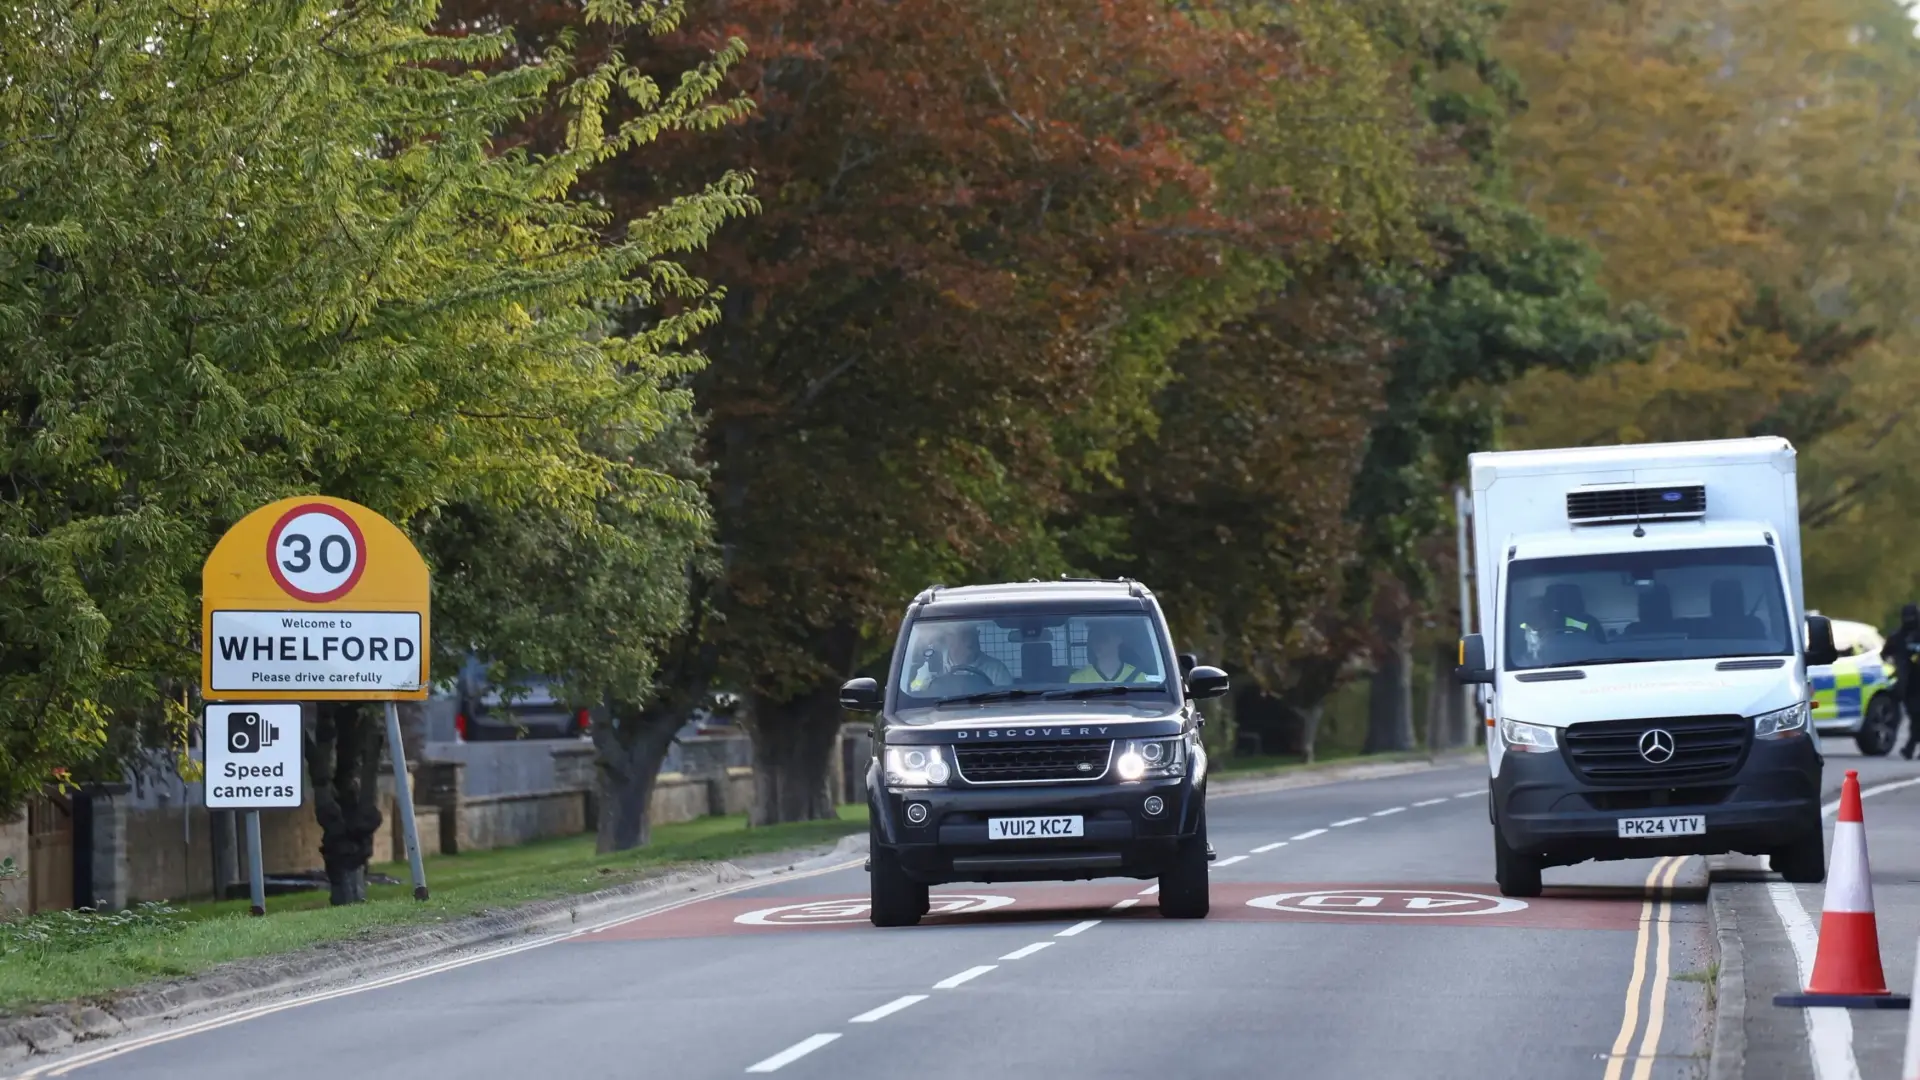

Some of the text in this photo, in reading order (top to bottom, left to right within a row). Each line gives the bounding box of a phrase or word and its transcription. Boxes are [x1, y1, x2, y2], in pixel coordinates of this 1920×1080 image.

[282, 533, 352, 574] 30
[281, 618, 352, 629] Welcome to
[219, 637, 414, 662] WHELFORD
[252, 672, 382, 684] Please drive carefully
[957, 726, 1109, 739] DISCOVERY
[223, 762, 284, 779] Speed
[213, 785, 294, 798] cameras
[1000, 819, 1072, 836] VU12 KCZ
[1625, 818, 1698, 834] PK24 VTV
